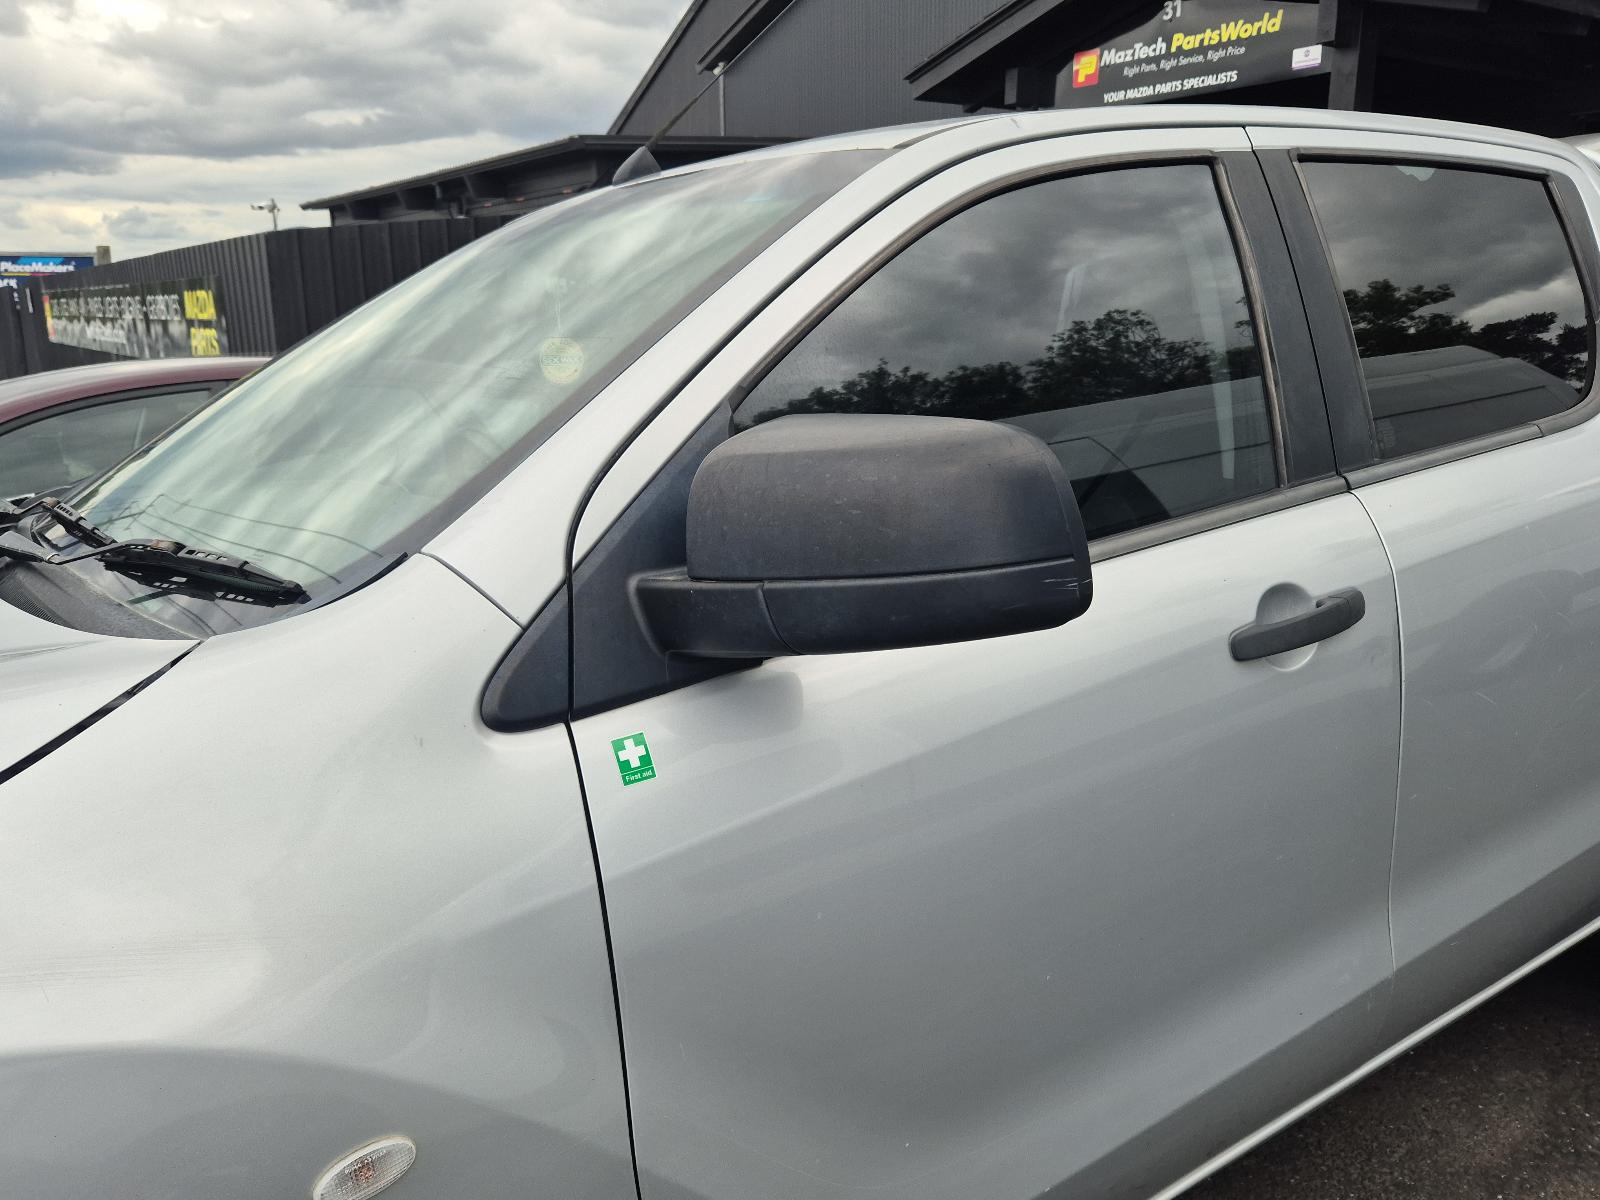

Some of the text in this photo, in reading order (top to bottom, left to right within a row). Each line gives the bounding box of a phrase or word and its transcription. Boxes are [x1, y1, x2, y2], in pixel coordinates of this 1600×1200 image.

[1162, 0, 1182, 21] 31
[1100, 9, 1284, 67] MazTech PartsWorld
[1123, 45, 1246, 78] Right Parts, Right Service, Right Price
[1103, 70, 1239, 104] YOUR MAZDA PARTS SPECIALISTS
[184, 289, 217, 321] MAZDA
[190, 327, 220, 357] PARTS
[625, 770, 653, 783] First aid
